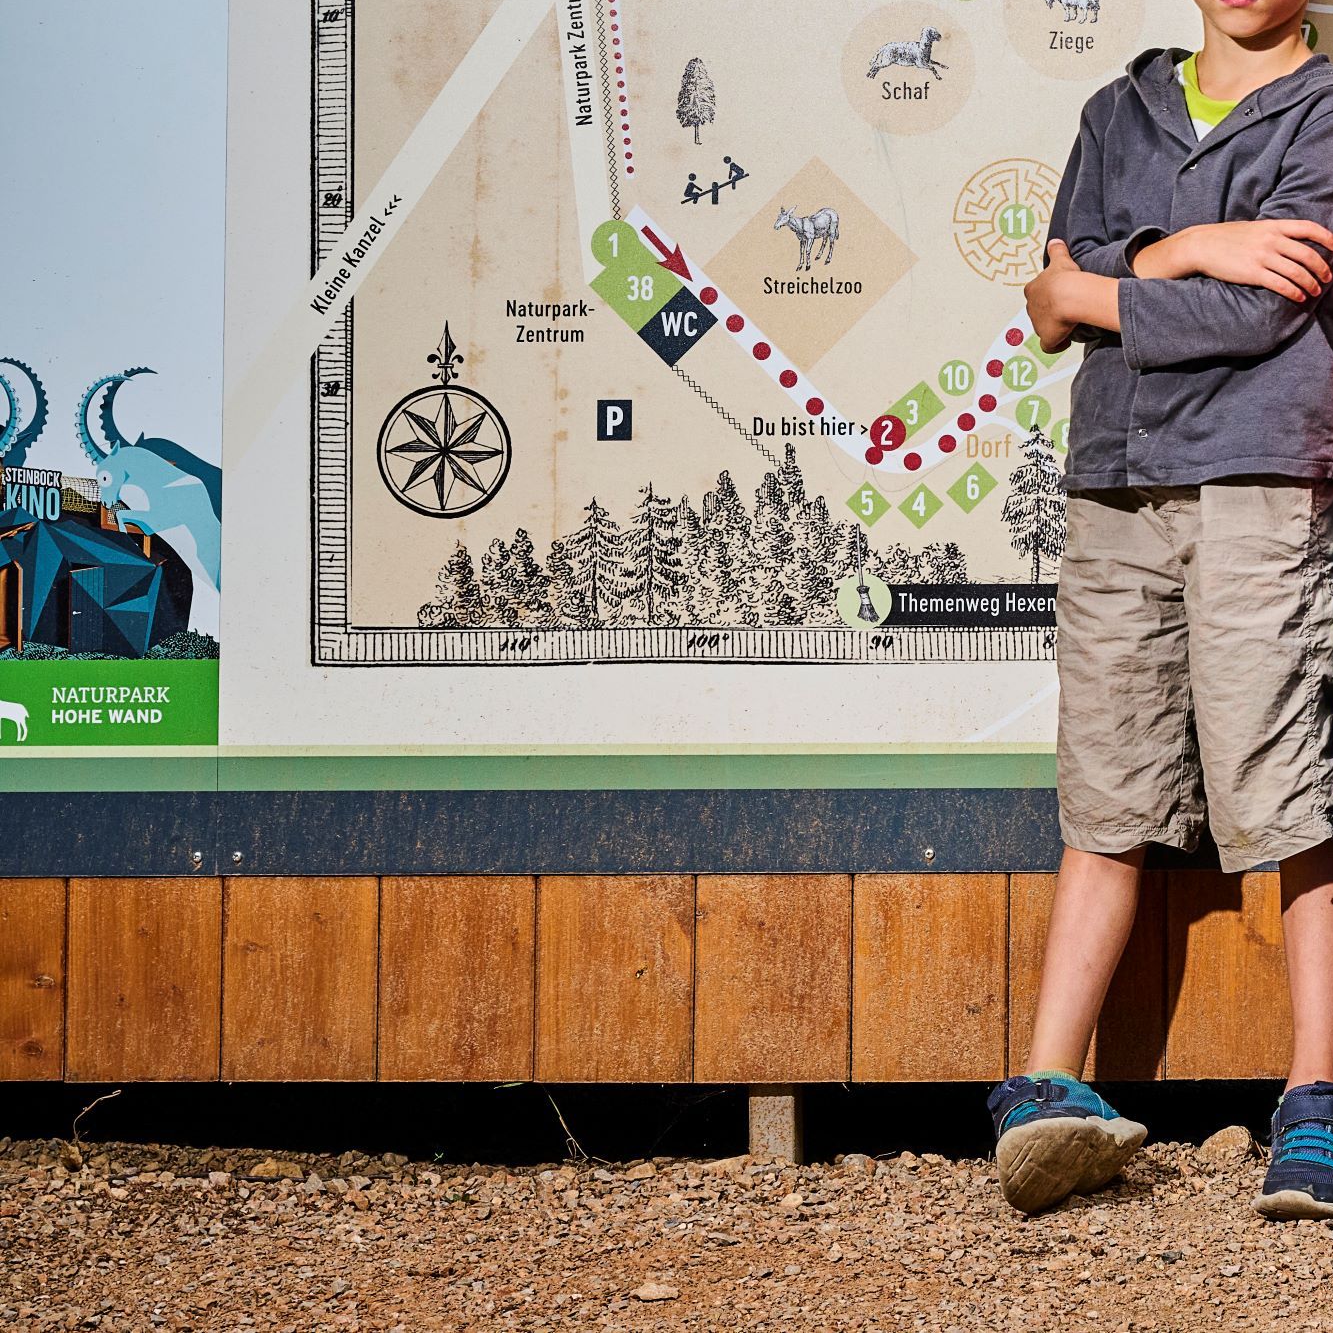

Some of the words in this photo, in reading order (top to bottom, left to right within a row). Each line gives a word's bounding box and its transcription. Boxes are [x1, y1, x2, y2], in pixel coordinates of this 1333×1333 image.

[1049, 31, 1094, 53] Ziege
[569, 43, 593, 126] Naturpark
[881, 81, 930, 101] Schaf
[1006, 209, 1027, 234] 11
[608, 234, 619, 258] 1
[309, 263, 353, 316] Kleine
[342, 215, 387, 270] Kanzel
[627, 276, 654, 301] 38
[763, 277, 863, 295] Streichelzoo
[506, 300, 596, 320] Naturpark-
[516, 326, 585, 344] Zentrum
[661, 313, 697, 337] WC
[943, 365, 969, 390] 10
[1008, 361, 1032, 386] 12
[606, 406, 624, 436] P
[906, 399, 919, 425] 3
[1027, 399, 1039, 424] 7
[753, 417, 778, 437] Du
[781, 415, 816, 436] bist
[820, 415, 856, 436] hier
[881, 420, 893, 445] 2
[966, 434, 1012, 458] Dorf
[5, 467, 61, 487] STEINBOCK
[966, 475, 980, 500] 6
[6, 484, 60, 521] KINO
[861, 490, 873, 515] 5
[912, 491, 926, 516] 4
[899, 592, 1000, 617] Themenweg
[52, 687, 171, 705] NATURPARK
[52, 709, 102, 724] HOHE
[108, 709, 163, 724] WAND
